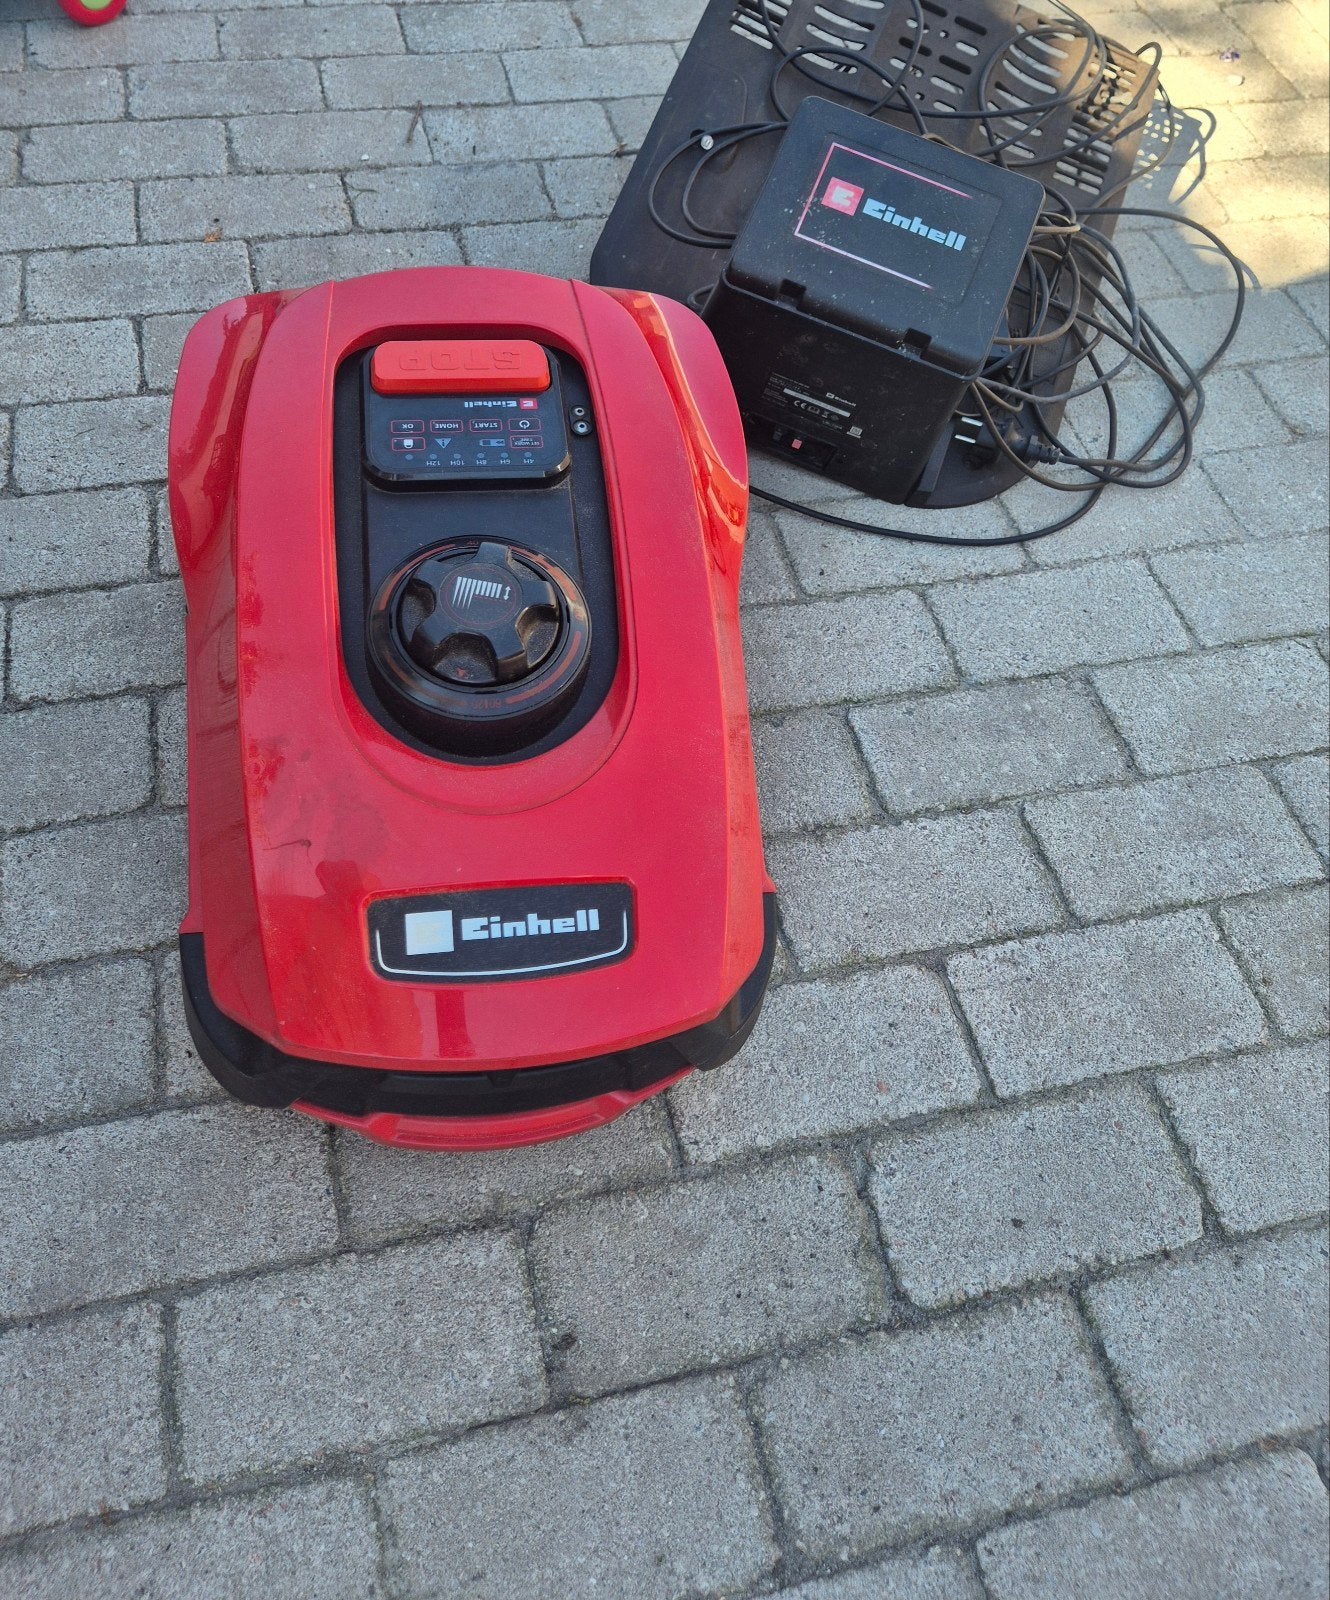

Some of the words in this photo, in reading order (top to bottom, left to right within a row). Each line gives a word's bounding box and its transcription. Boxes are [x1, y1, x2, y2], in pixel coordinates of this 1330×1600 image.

[862, 198, 966, 251] Einhell
[399, 349, 520, 371] STOP
[464, 400, 517, 408] Einhell
[461, 909, 600, 941] Einhell
